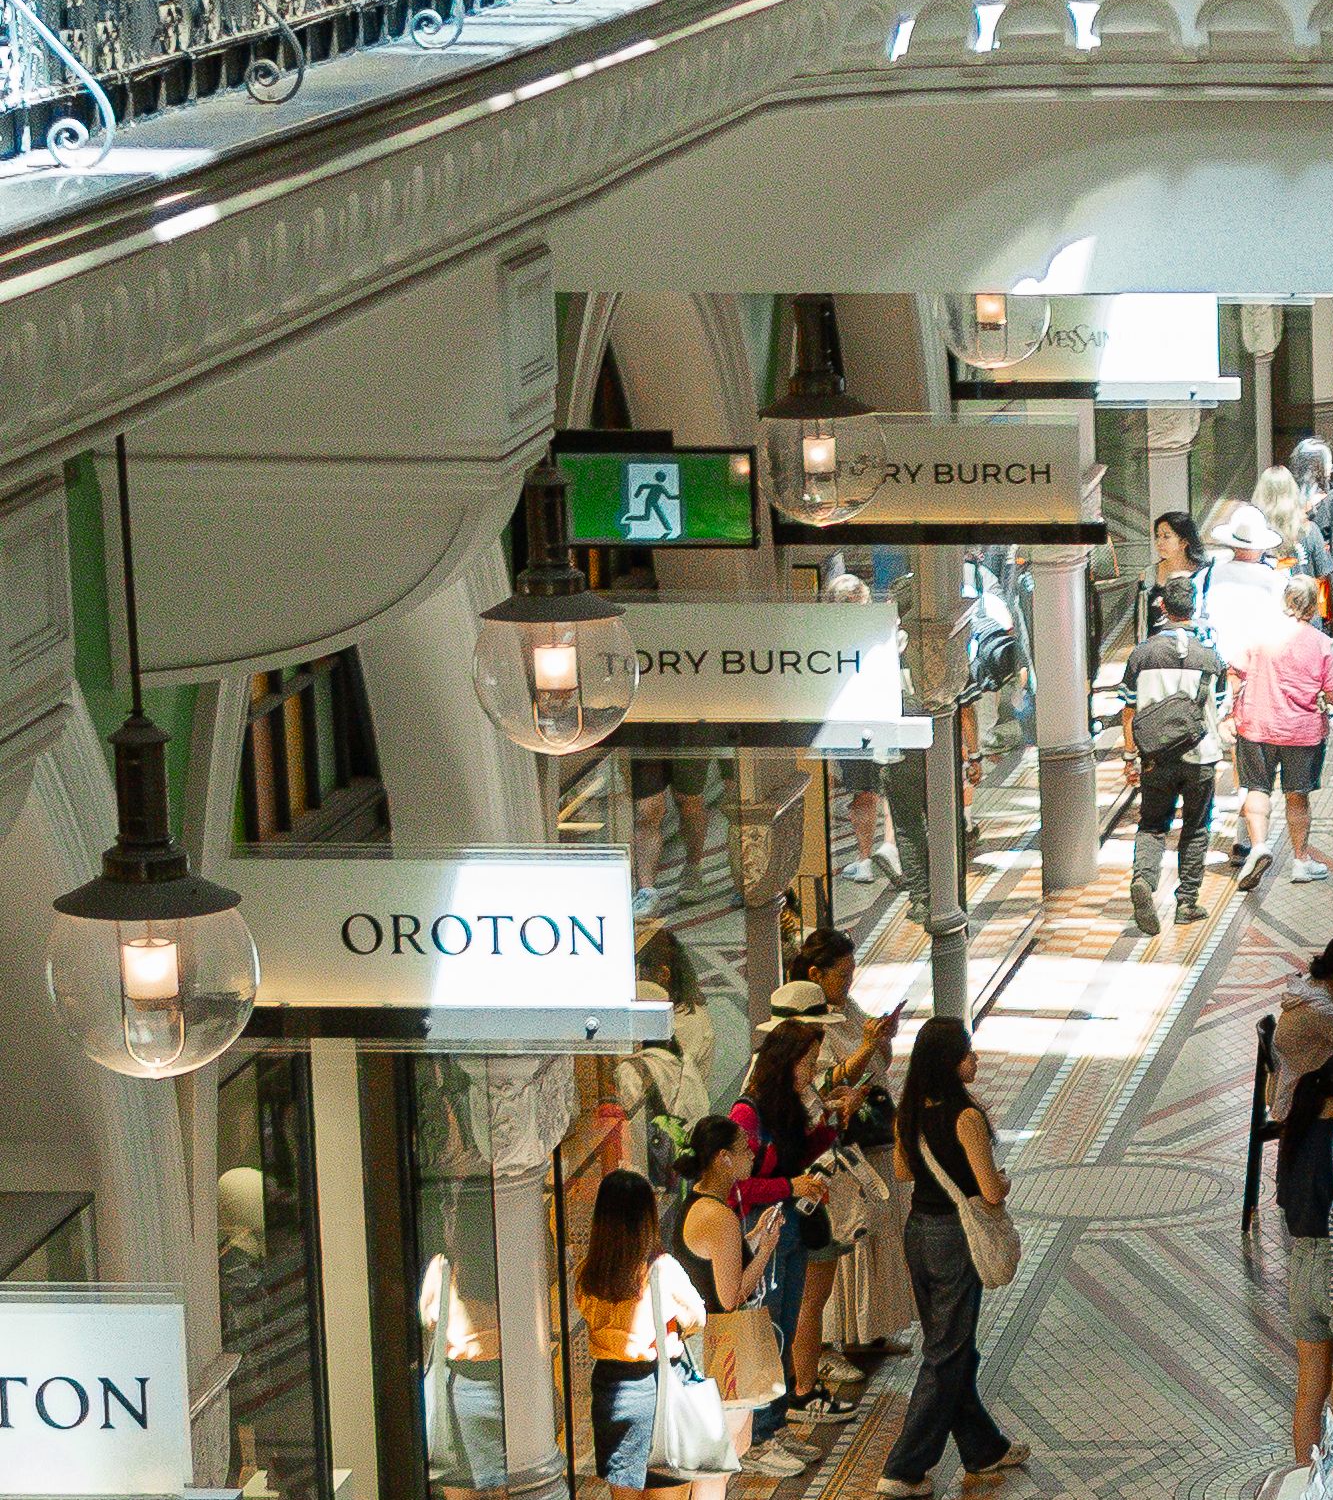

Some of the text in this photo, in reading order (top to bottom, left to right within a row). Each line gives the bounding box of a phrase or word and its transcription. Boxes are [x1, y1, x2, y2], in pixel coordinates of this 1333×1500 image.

[933, 463, 1052, 485] BURCH
[598, 649, 861, 675] TORY BURCH
[339, 911, 607, 957] OROTON
